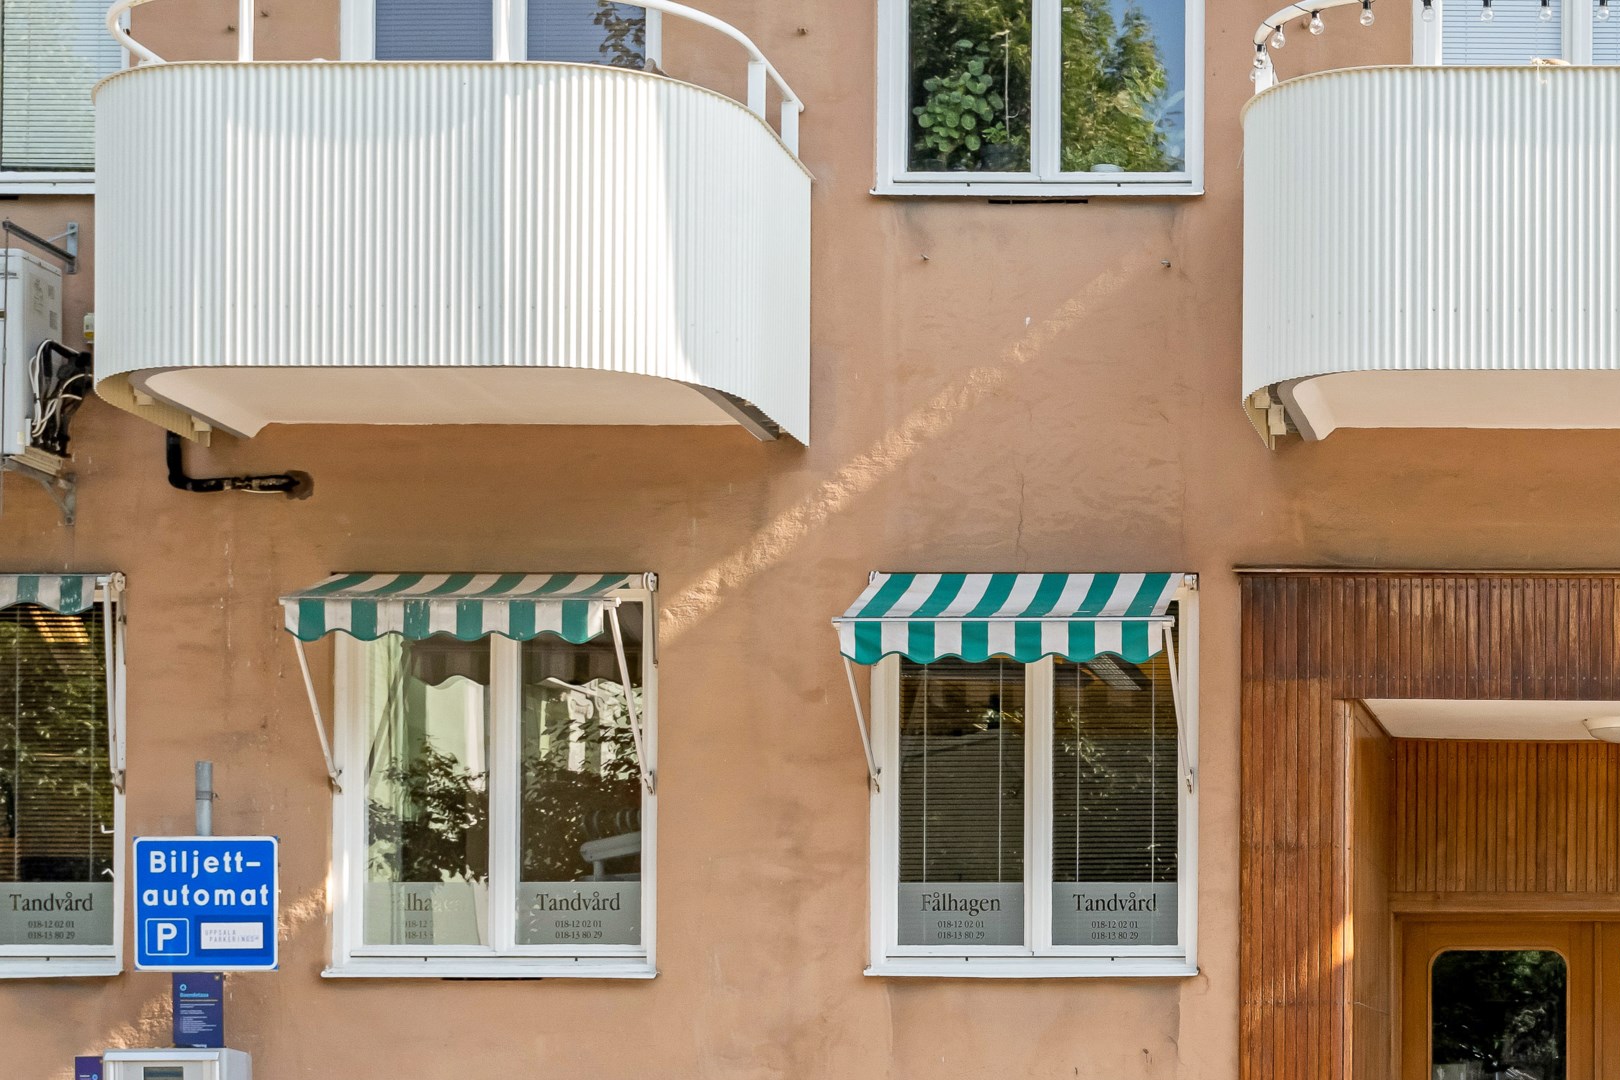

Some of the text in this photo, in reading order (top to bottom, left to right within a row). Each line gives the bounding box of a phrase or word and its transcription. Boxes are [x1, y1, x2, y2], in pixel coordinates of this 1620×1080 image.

[150, 850, 261, 878] Biljett-
[9, 891, 94, 911] Tandvård
[142, 884, 269, 906] automat
[536, 891, 621, 911] Tandvård
[920, 891, 1001, 916] Fålhagen
[1072, 891, 1157, 912] Tandvård
[555, 920, 602, 928] 018-12 02 01
[937, 920, 984, 928] 018-12 02 01
[1091, 920, 1138, 928] 018-12 02 01
[157, 923, 178, 951] P
[555, 931, 603, 939] 018-13 80 29
[937, 931, 985, 939] 018-13 80 29
[1091, 931, 1138, 939] 018-13 80 29
